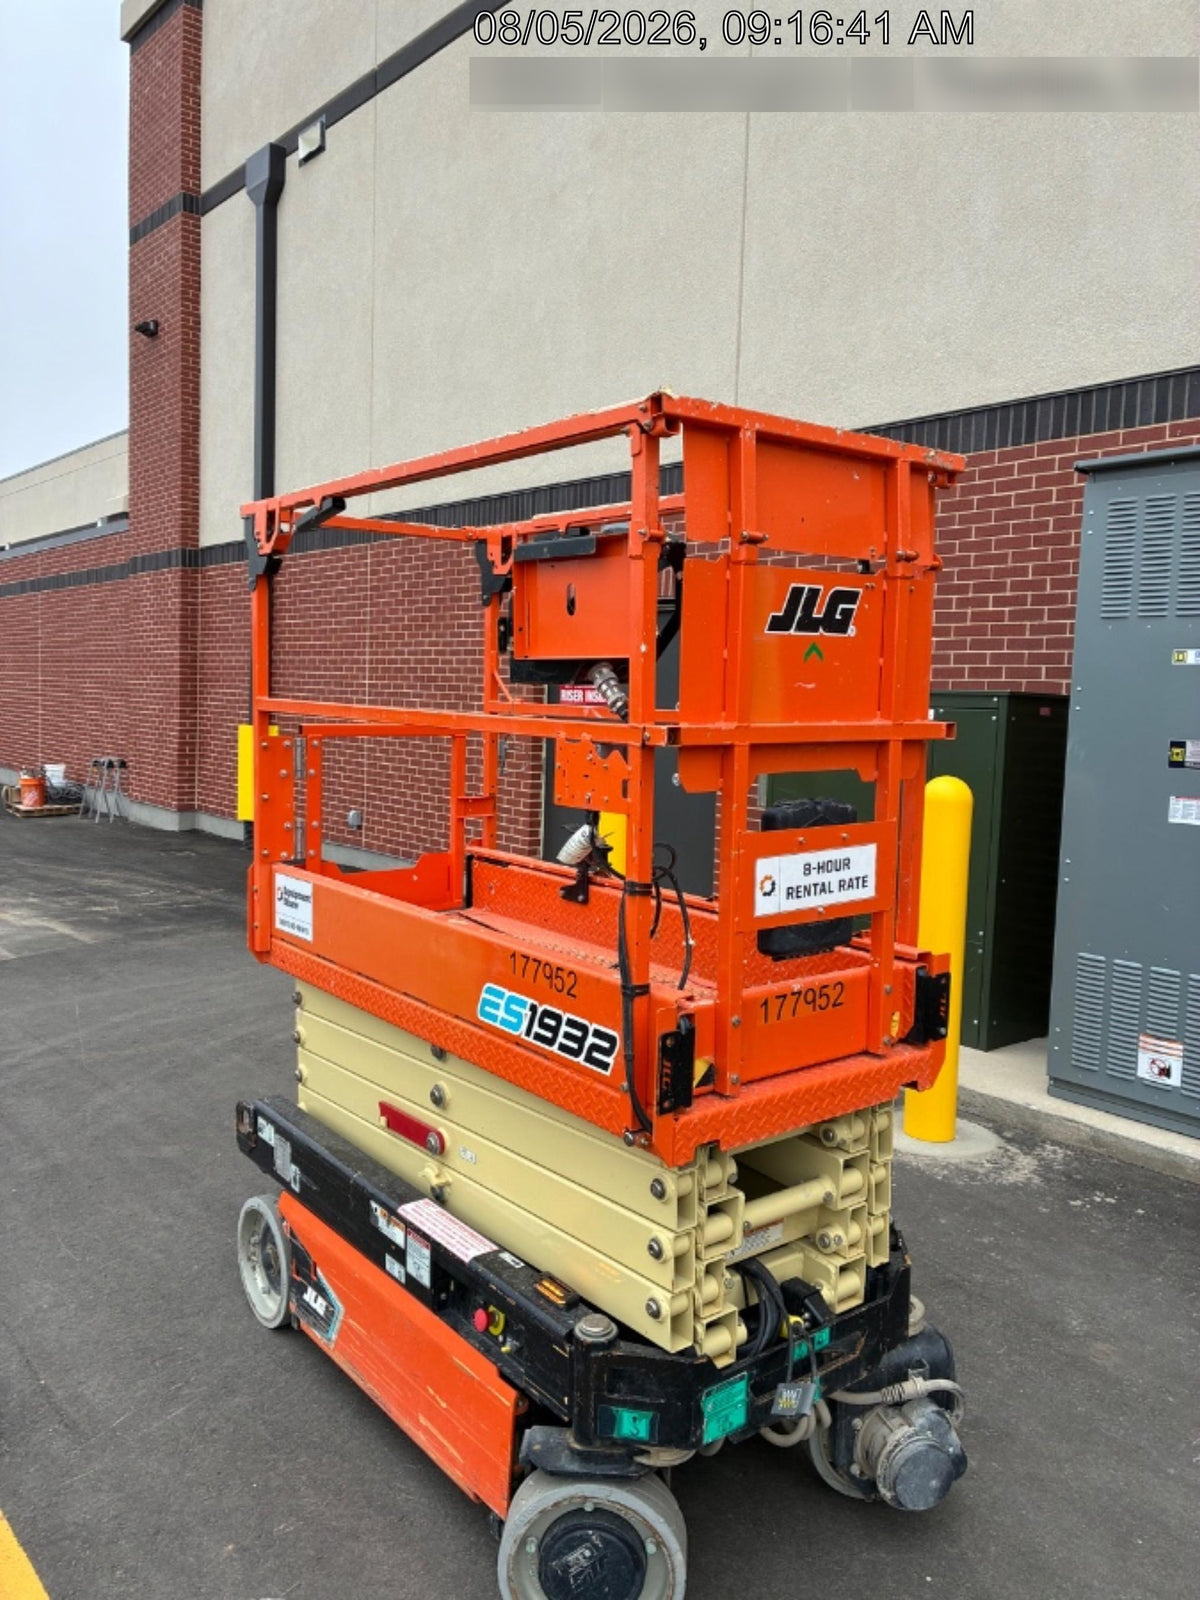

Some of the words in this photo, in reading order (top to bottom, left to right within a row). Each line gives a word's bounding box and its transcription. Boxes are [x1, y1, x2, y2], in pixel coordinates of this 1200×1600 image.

[764, 583, 863, 636] JLG
[560, 689, 583, 702] RISER
[786, 881, 834, 900] RENTAL
[838, 875, 869, 892] RATE
[803, 857, 851, 876] 8-HOUR
[509, 951, 578, 999] 177952
[760, 980, 844, 1024] 177952
[478, 983, 619, 1076] ES1932
